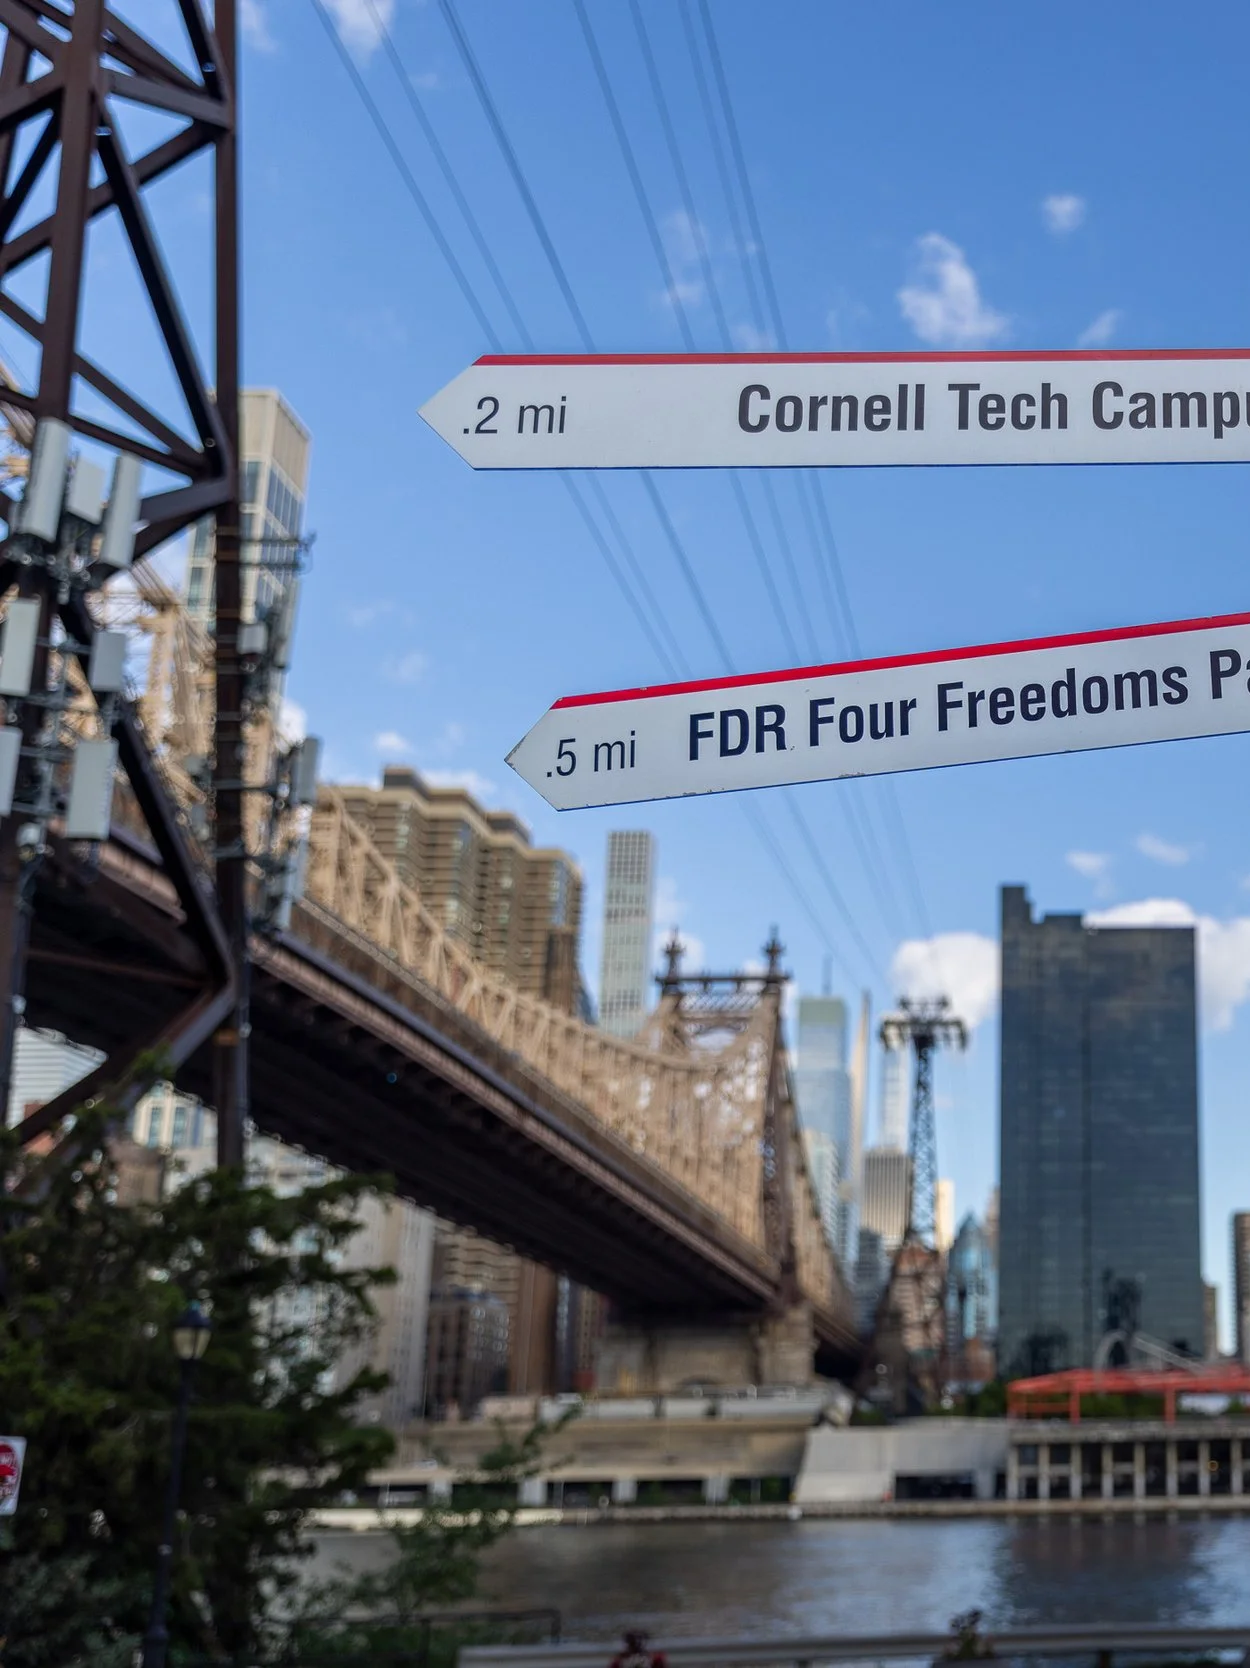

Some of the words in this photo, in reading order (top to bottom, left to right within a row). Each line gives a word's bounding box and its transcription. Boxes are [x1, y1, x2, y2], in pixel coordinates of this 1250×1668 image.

[463, 396, 501, 435] .2
[517, 395, 567, 434] mi
[738, 383, 926, 434] Cornell
[947, 382, 1068, 431] Tech
[689, 704, 788, 762] FDR
[809, 696, 917, 748] Four
[937, 665, 1189, 732] Freedoms
[546, 736, 577, 778] .5
[593, 729, 636, 773] mi
